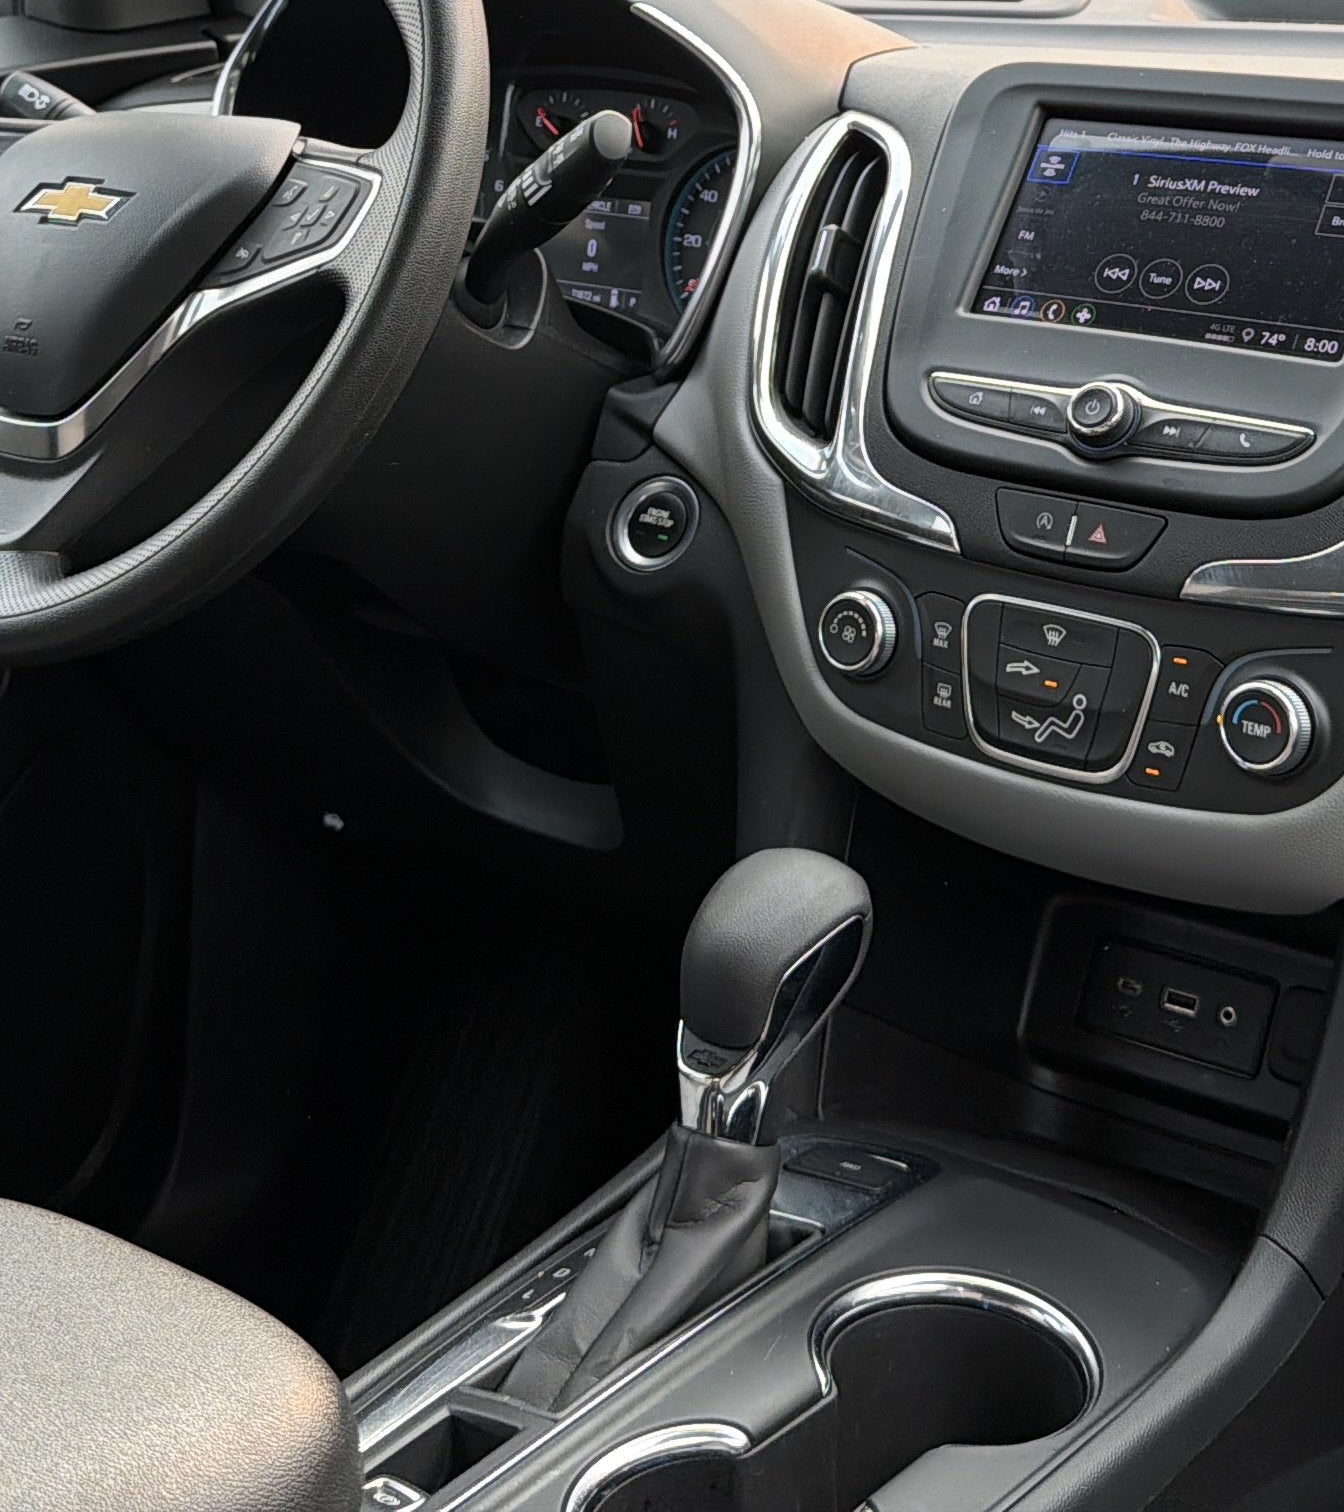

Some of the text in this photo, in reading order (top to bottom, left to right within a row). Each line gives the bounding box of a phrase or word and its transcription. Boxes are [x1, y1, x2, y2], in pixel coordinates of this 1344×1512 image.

[667, 127, 677, 139] H
[1167, 136, 1233, 153] The Highway
[1233, 141, 1258, 153] FOX
[1305, 148, 1333, 160] Hold
[494, 179, 504, 192] 6
[1130, 173, 1262, 197] 1 SiriusXM Preview
[699, 189, 718, 203] 40
[1135, 191, 1241, 212] Great Offer Now!
[1138, 208, 1226, 229] 844-711-8800
[682, 234, 703, 248] 20
[1016, 228, 1036, 241] FM
[587, 238, 598, 258] 0
[992, 263, 1021, 276] More
[1146, 272, 1173, 286] Tune
[1209, 322, 1237, 333] 4G LTE
[1302, 336, 1340, 355] 8:00
[932, 637, 949, 649] MAX
[1168, 681, 1190, 698] A/C
[933, 695, 952, 709] REAR
[1241, 719, 1272, 738] TEMP
